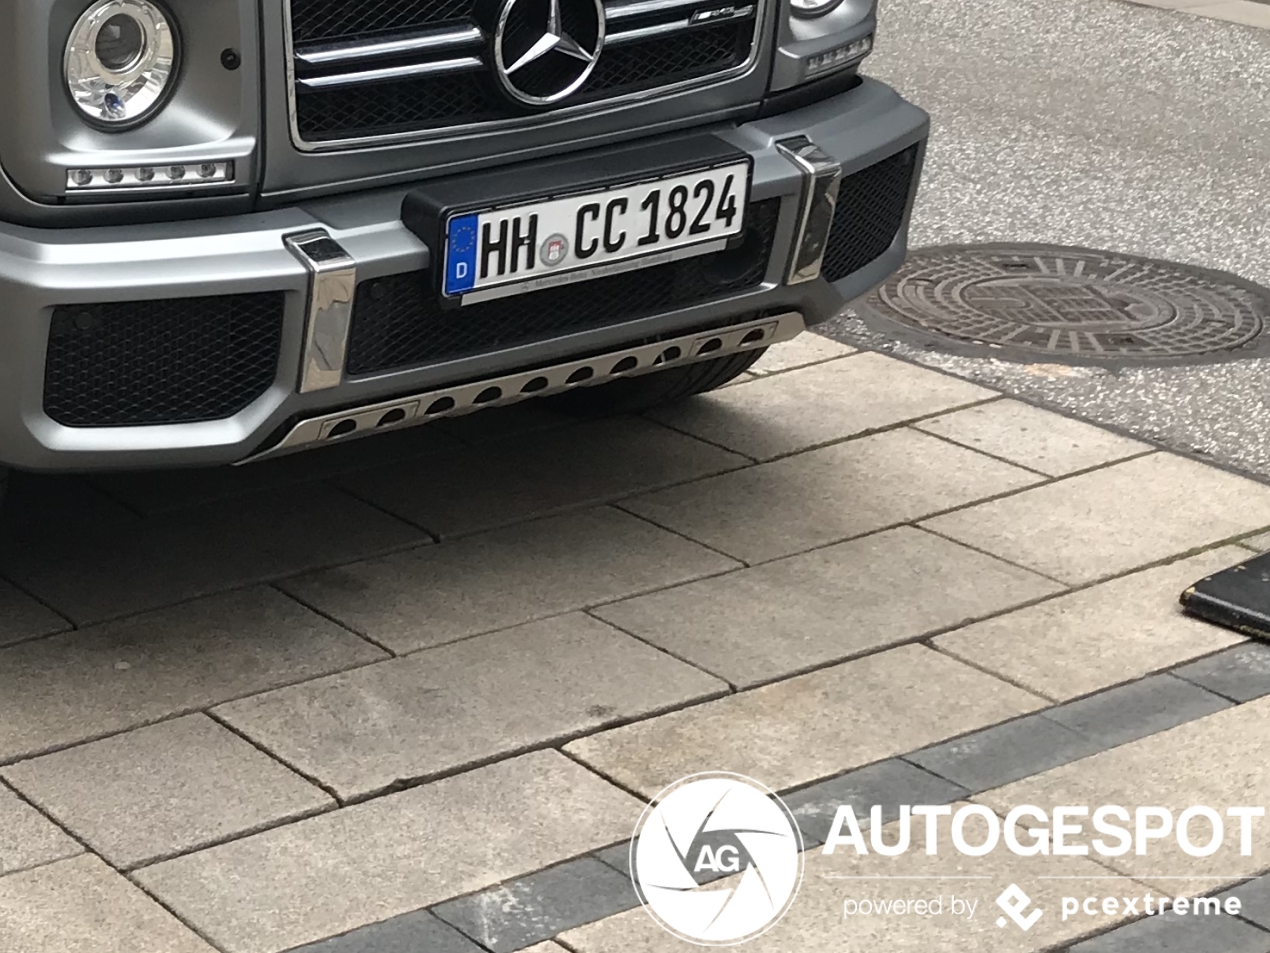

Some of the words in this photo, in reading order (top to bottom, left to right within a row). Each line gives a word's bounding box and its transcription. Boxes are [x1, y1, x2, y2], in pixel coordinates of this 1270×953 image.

[479, 213, 538, 279] HH
[575, 196, 629, 259] CC
[637, 174, 737, 247] 1824
[456, 261, 468, 279] D
